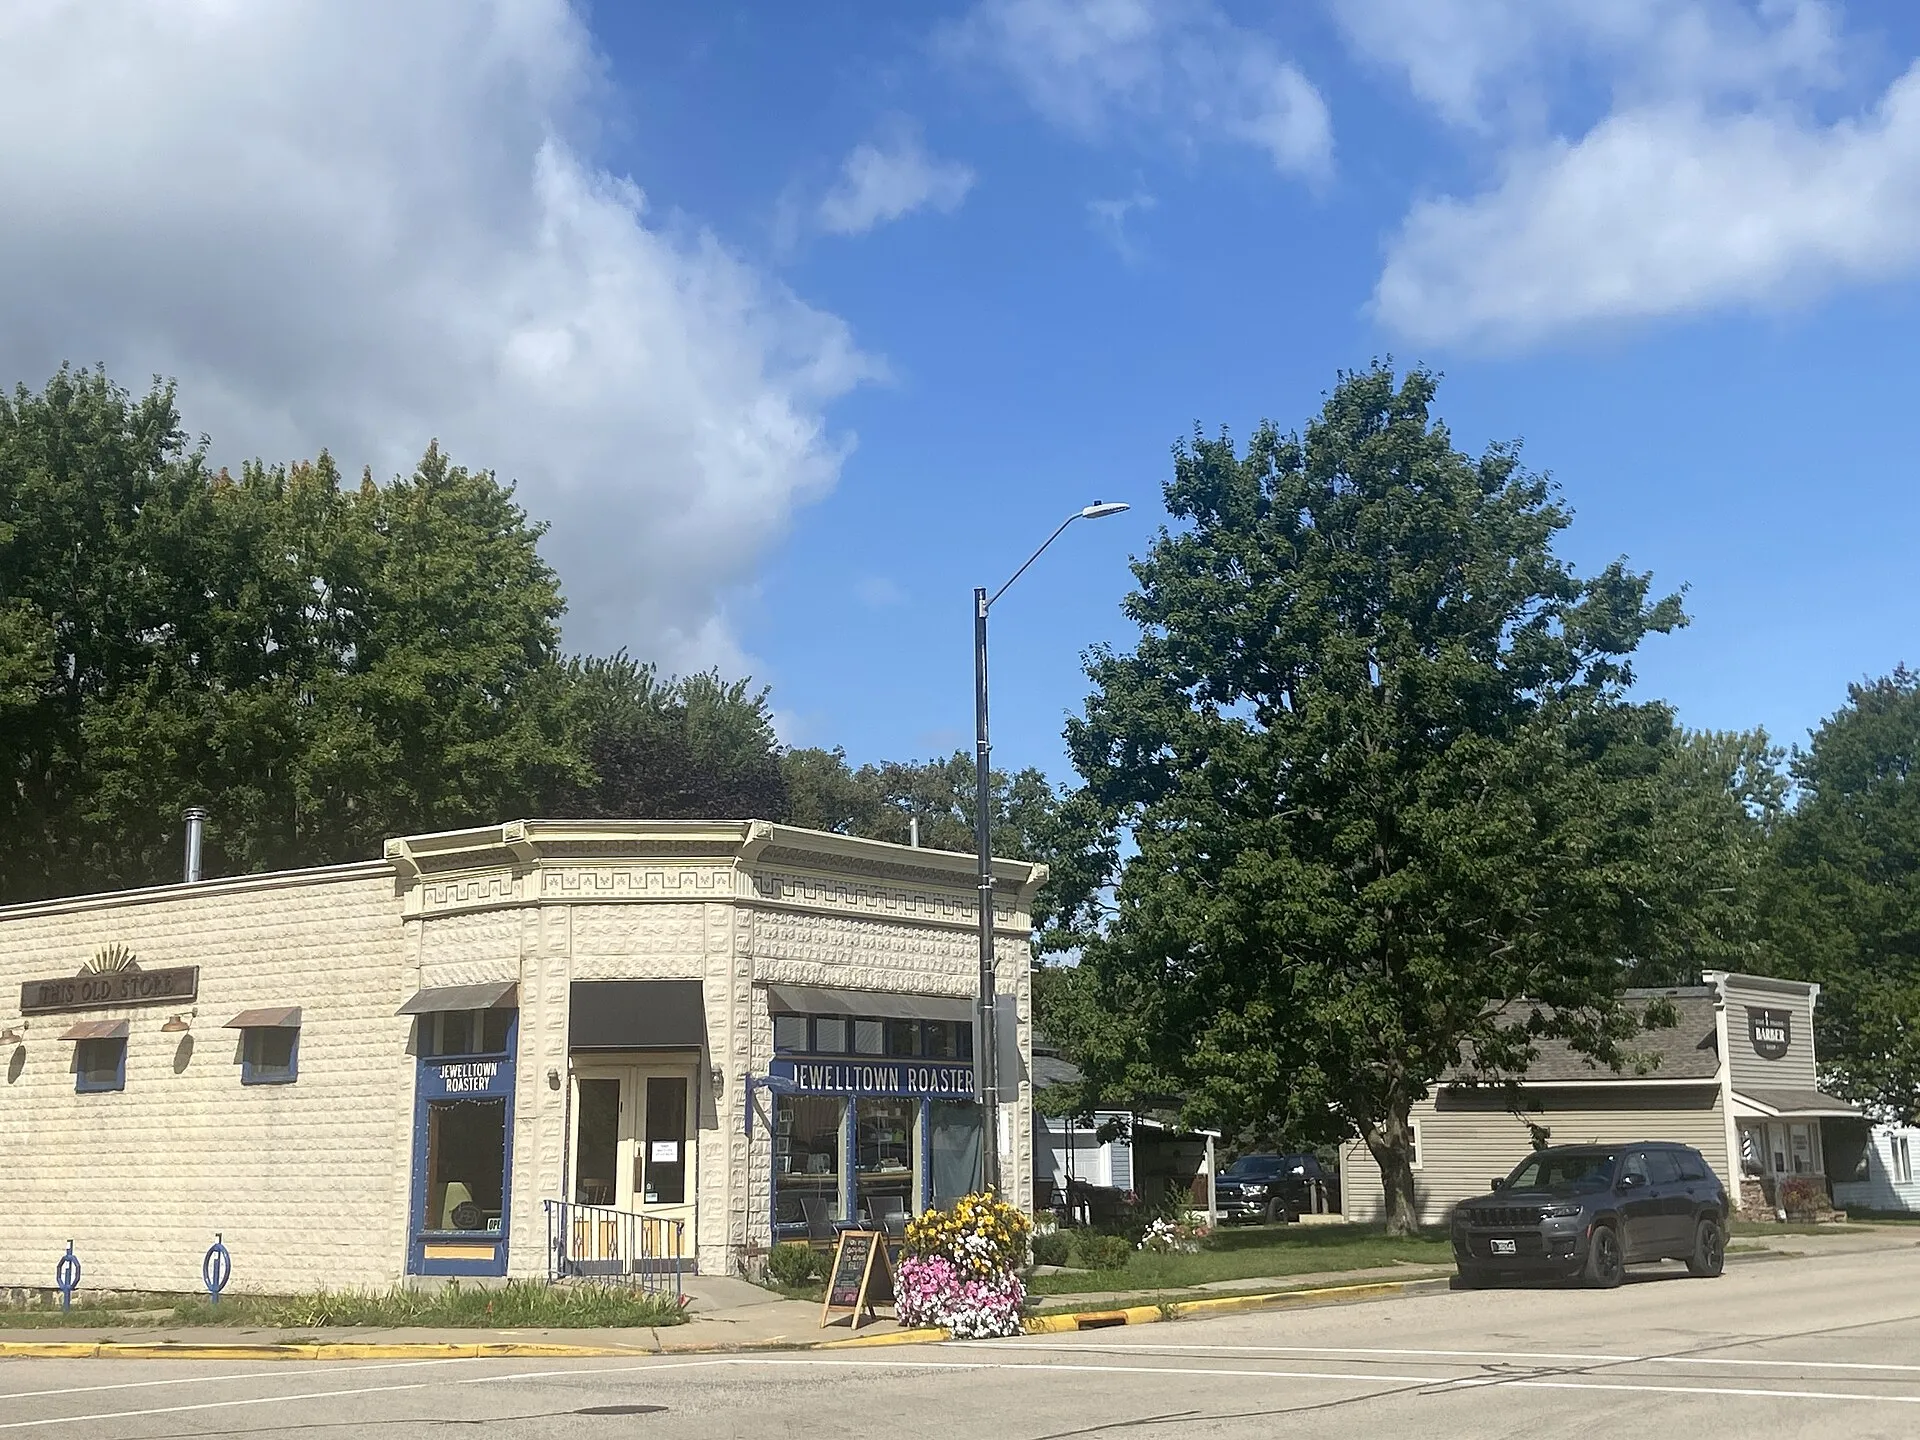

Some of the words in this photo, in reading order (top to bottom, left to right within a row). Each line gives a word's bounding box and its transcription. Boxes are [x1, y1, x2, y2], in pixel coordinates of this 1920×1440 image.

[39, 984, 75, 1003] THIS
[82, 980, 111, 1000] OLD
[121, 975, 174, 998] STORE
[439, 1062, 498, 1078] JEWELLTOWN
[446, 1077, 490, 1092] ROASTERY
[793, 1064, 899, 1092] JEWELLTOWN
[908, 1067, 974, 1093] ROASTER
[488, 1219, 501, 1230] OPE
